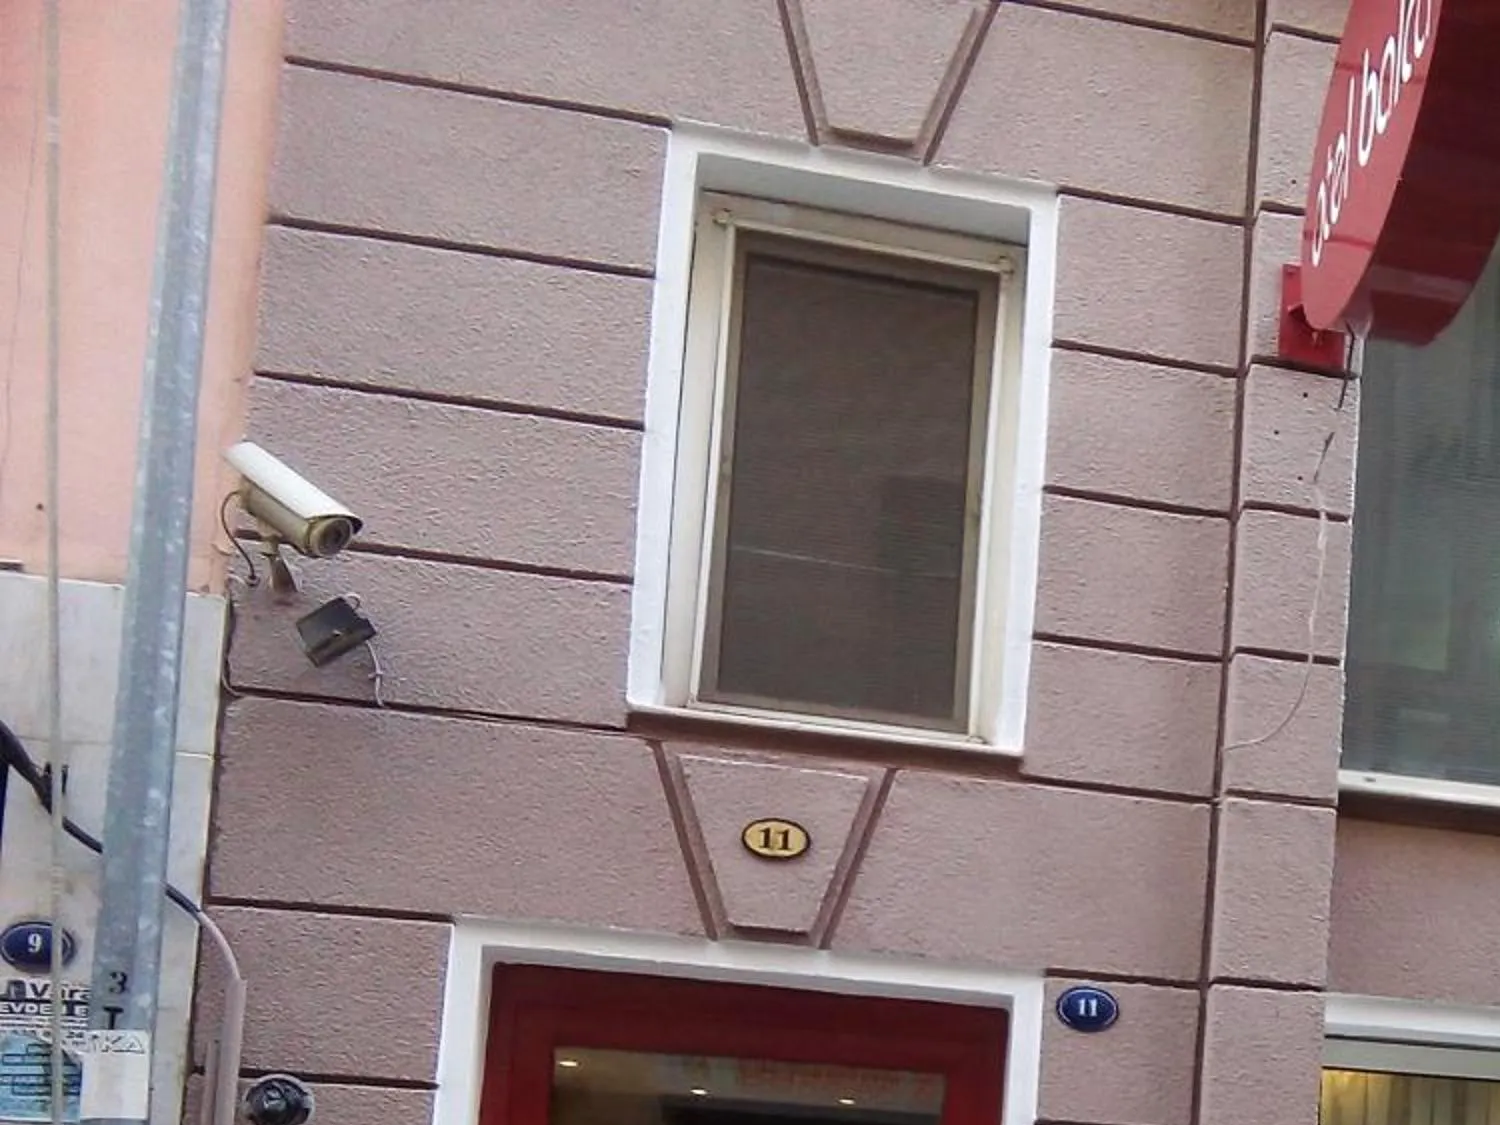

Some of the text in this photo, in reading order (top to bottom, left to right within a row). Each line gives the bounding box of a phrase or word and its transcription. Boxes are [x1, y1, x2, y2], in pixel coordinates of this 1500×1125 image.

[758, 827, 792, 851] 11
[28, 933, 42, 953] 9
[109, 971, 128, 994] 3
[1079, 998, 1098, 1017] 11
